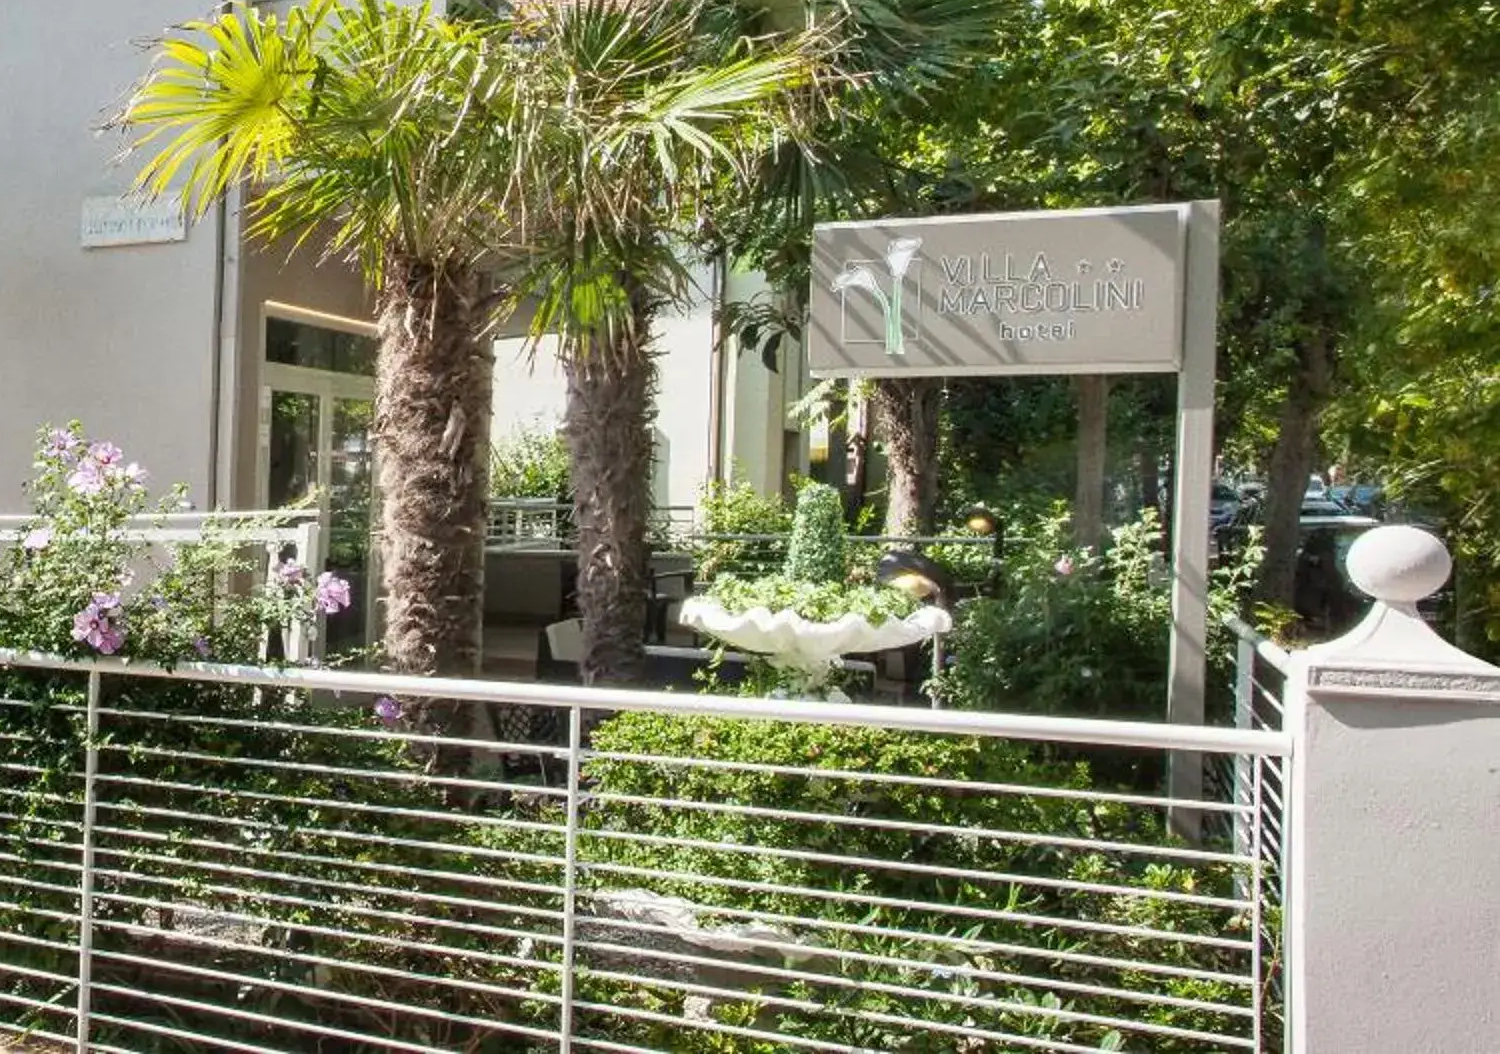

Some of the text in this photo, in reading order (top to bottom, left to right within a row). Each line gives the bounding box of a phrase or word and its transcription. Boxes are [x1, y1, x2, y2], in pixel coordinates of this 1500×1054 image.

[941, 251, 1053, 286] VILLA
[938, 279, 1145, 316] MARCOLINI
[999, 320, 1077, 341] hotel
